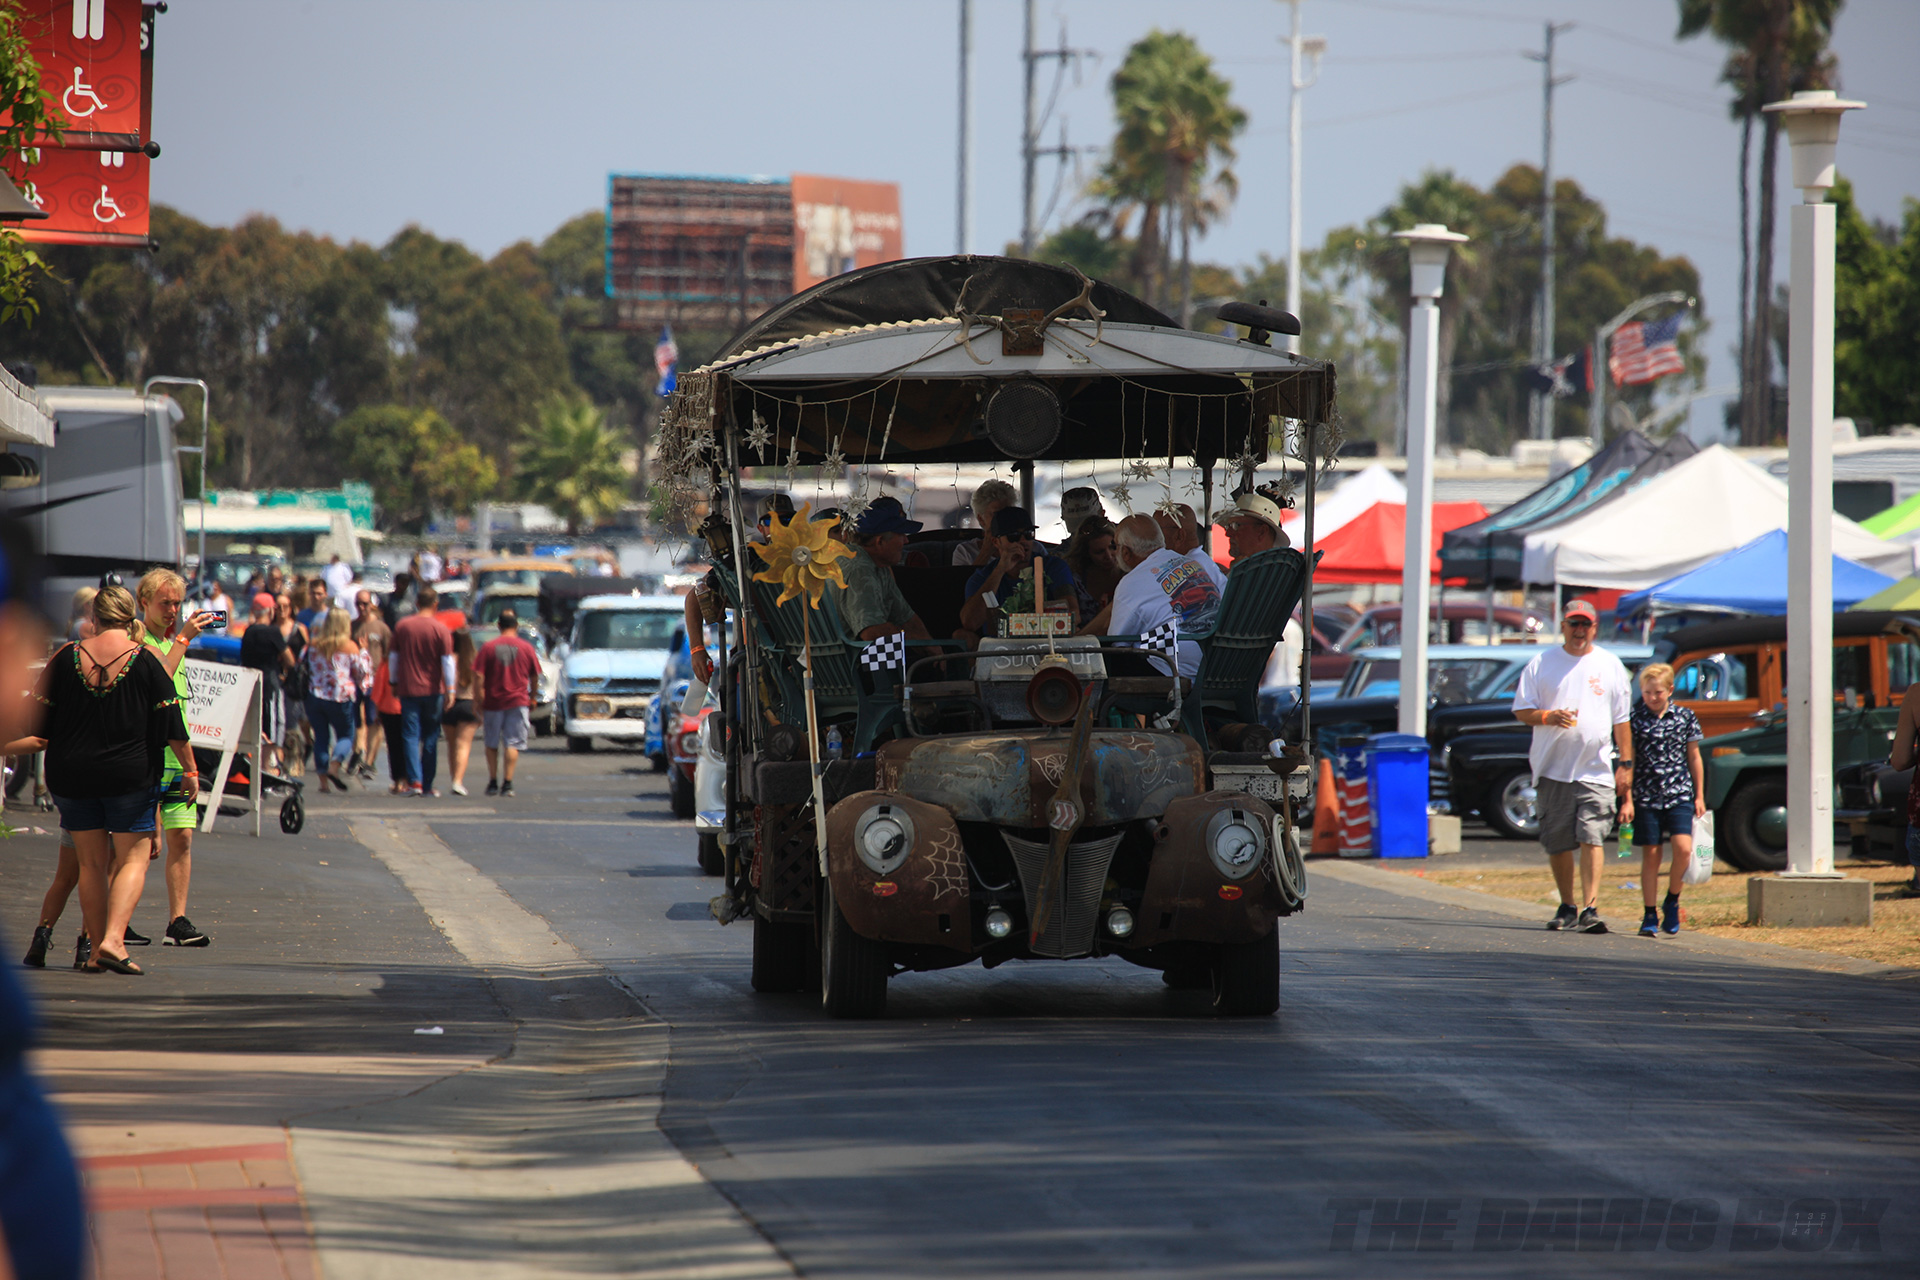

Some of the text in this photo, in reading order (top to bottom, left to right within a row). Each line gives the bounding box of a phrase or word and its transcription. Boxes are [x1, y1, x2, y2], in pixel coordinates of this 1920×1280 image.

[1161, 567, 1189, 595] CAR
[185, 666, 238, 685] RISTBANDS
[208, 686, 222, 696] BE
[190, 707, 201, 716] AT
[188, 723, 222, 737] TIMES
